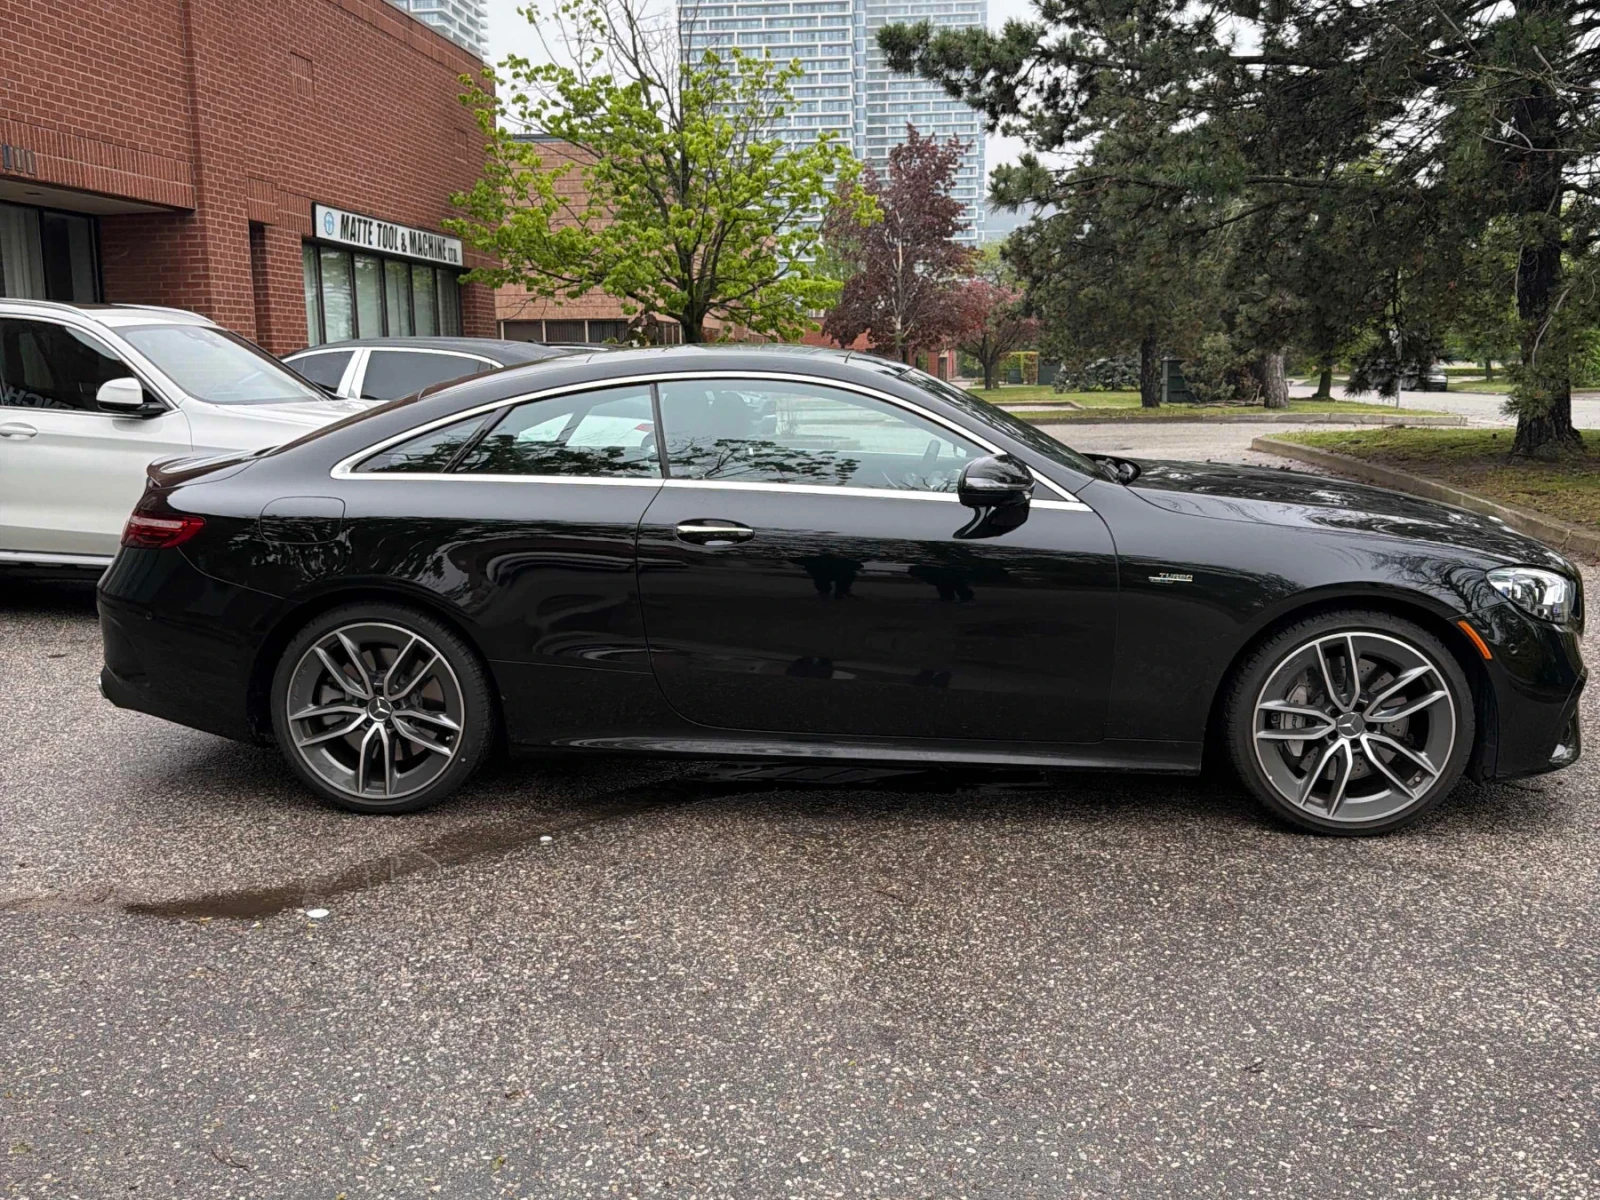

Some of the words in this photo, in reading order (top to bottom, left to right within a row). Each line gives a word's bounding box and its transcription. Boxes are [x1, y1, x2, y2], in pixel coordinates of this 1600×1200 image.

[340, 213, 373, 245] MATTE
[377, 223, 399, 251] TOOL
[401, 232, 408, 253] &
[409, 230, 447, 261] MACHINE
[448, 247, 460, 263] LTD.
[1159, 572, 1193, 581] TURBO
